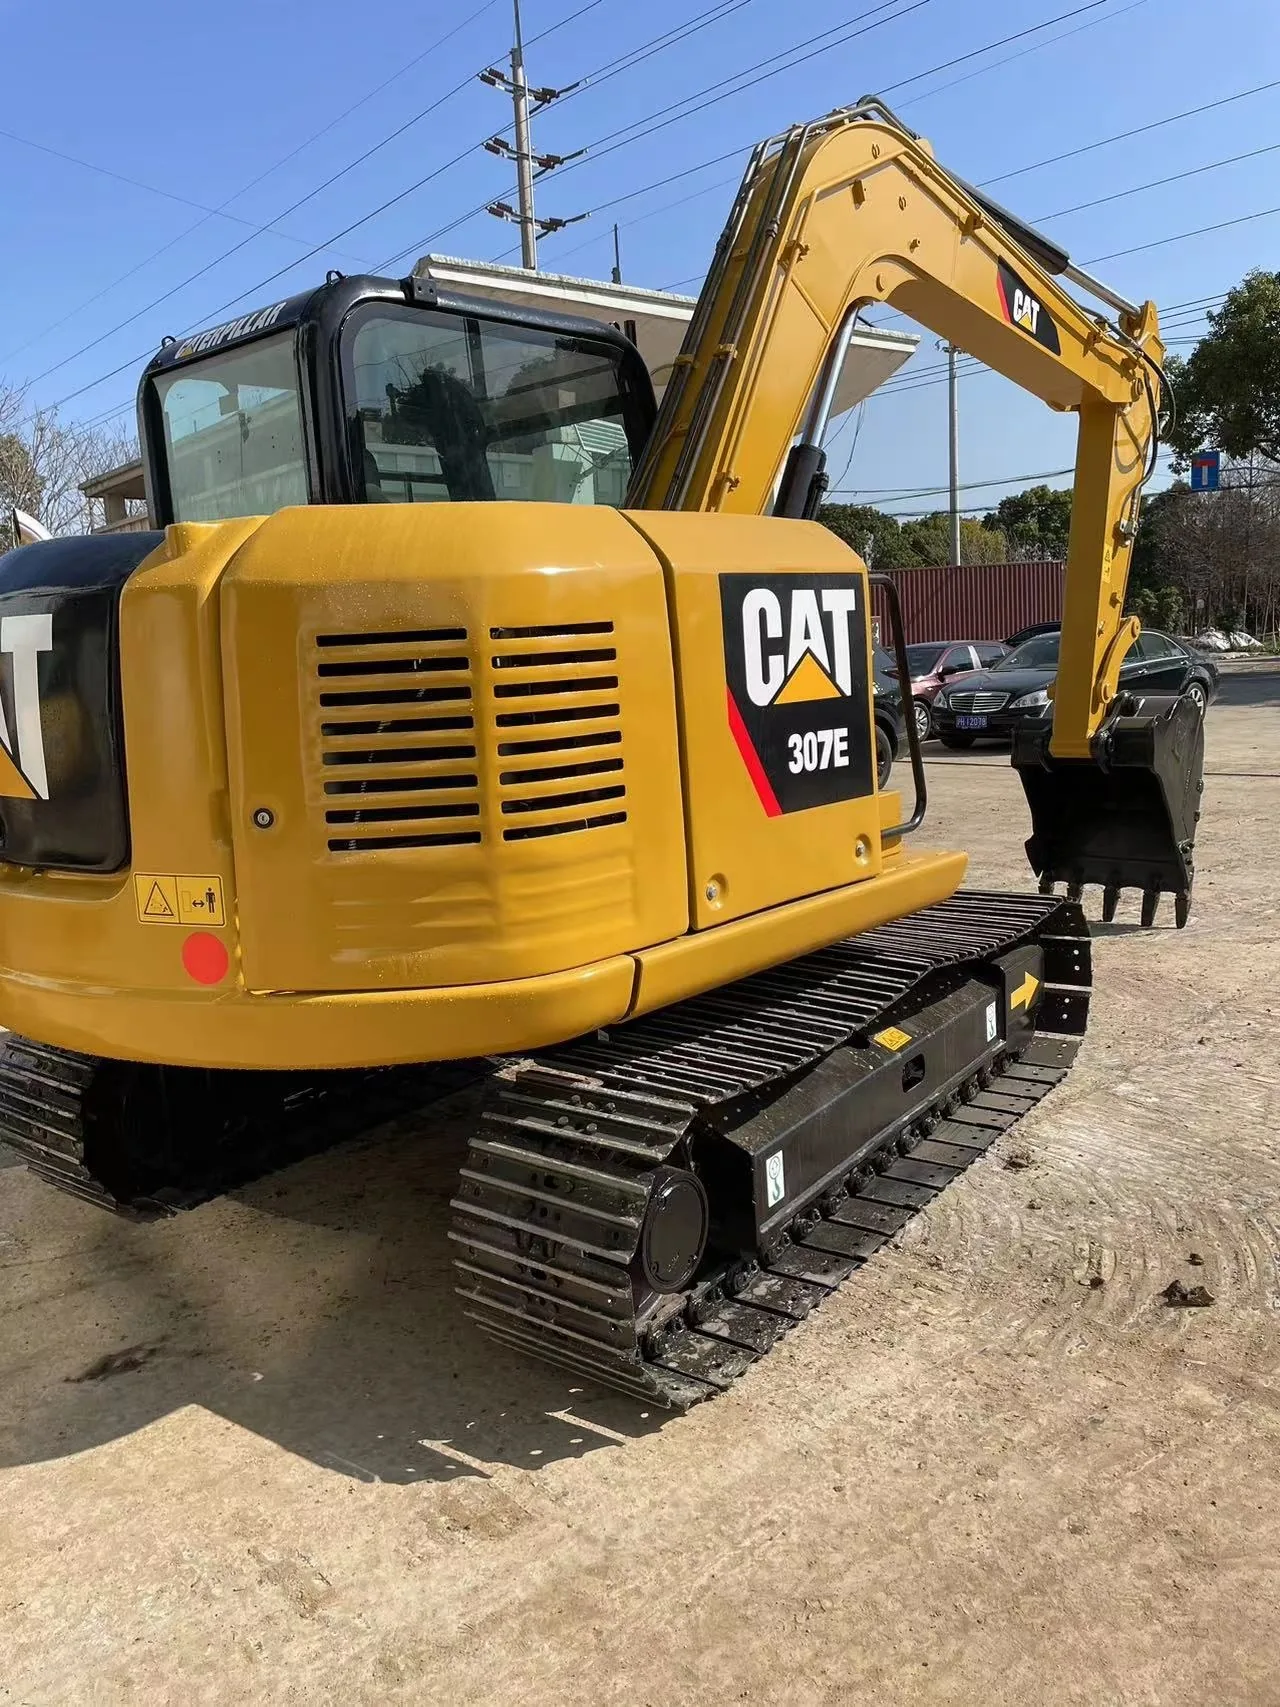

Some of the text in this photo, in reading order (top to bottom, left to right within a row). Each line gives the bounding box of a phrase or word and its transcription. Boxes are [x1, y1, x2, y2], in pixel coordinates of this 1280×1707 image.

[175, 302, 287, 360] CATERPILLAR
[1013, 288, 1040, 334] CAT
[742, 588, 856, 707] CAT
[788, 727, 849, 774] 307E
